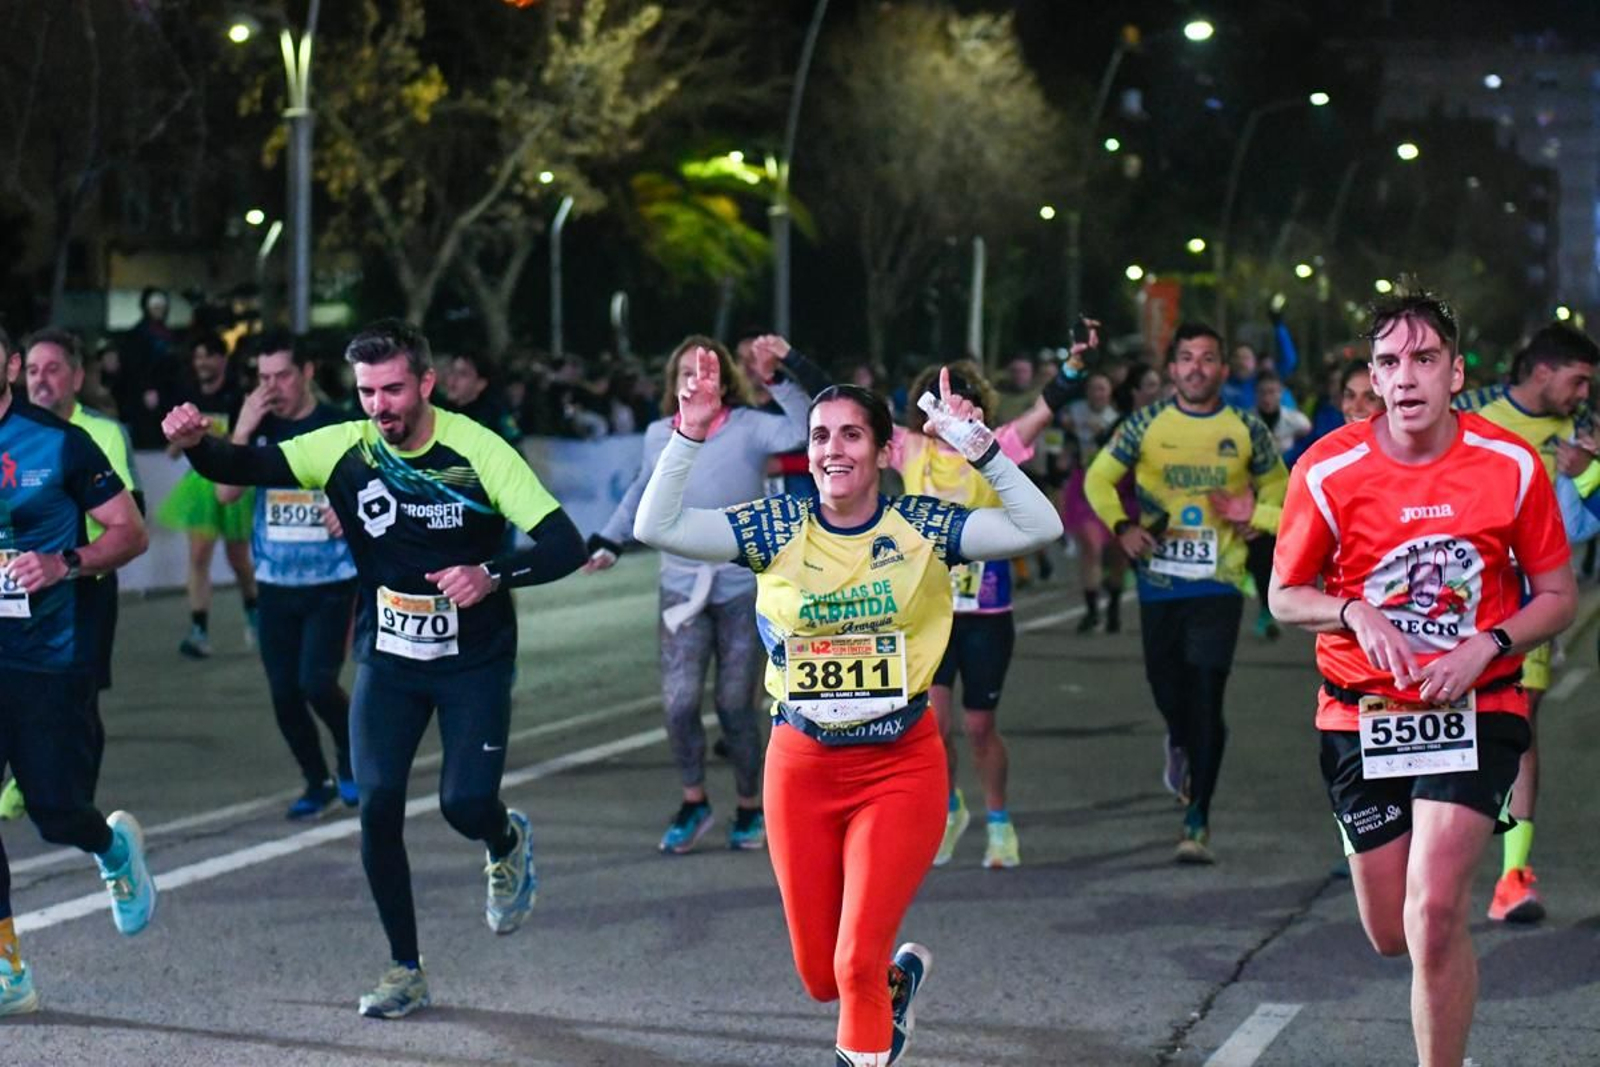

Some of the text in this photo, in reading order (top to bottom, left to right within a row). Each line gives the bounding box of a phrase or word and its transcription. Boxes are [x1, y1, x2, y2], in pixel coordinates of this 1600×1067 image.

[271, 505, 322, 524] 8509
[401, 502, 464, 517] CROSSFIT
[427, 516, 463, 529] JAEN
[872, 579, 891, 596] DE
[799, 596, 897, 619] ALBAIDA
[383, 607, 449, 636] 9770
[1390, 619, 1459, 637] RECIO
[797, 658, 889, 690] 3811
[868, 717, 903, 736] MAX
[1371, 713, 1466, 745] 5508
